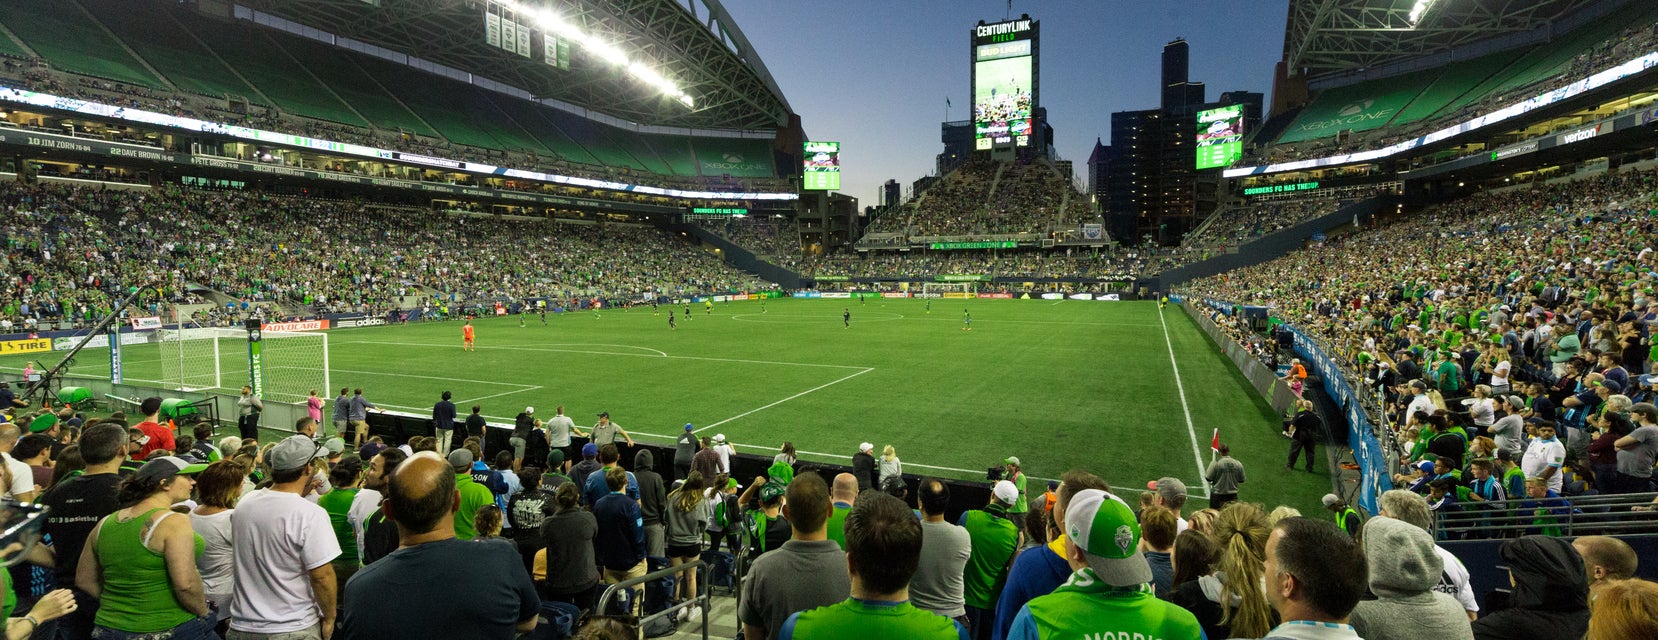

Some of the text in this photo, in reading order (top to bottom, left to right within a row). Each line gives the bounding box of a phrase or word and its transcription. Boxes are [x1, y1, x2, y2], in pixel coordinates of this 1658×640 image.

[992, 33, 1015, 42] FIELD
[980, 43, 1026, 57] BUD LIGHT
[1347, 108, 1394, 123] ONE
[1564, 126, 1597, 144] verizon
[28, 137, 40, 145] 10
[41, 139, 55, 148] JIM
[56, 140, 75, 149] ZORN
[122, 149, 137, 157] DAVE
[138, 151, 160, 160] BROWN
[195, 157, 210, 166] PETE
[704, 162, 767, 170] XBOX ONE
[1244, 186, 1274, 195] SOUNDERS
[264, 321, 320, 332] ADVOCARE
[356, 318, 386, 327] adidas
[18, 341, 47, 351] TIRE
[253, 353, 260, 363] FC
